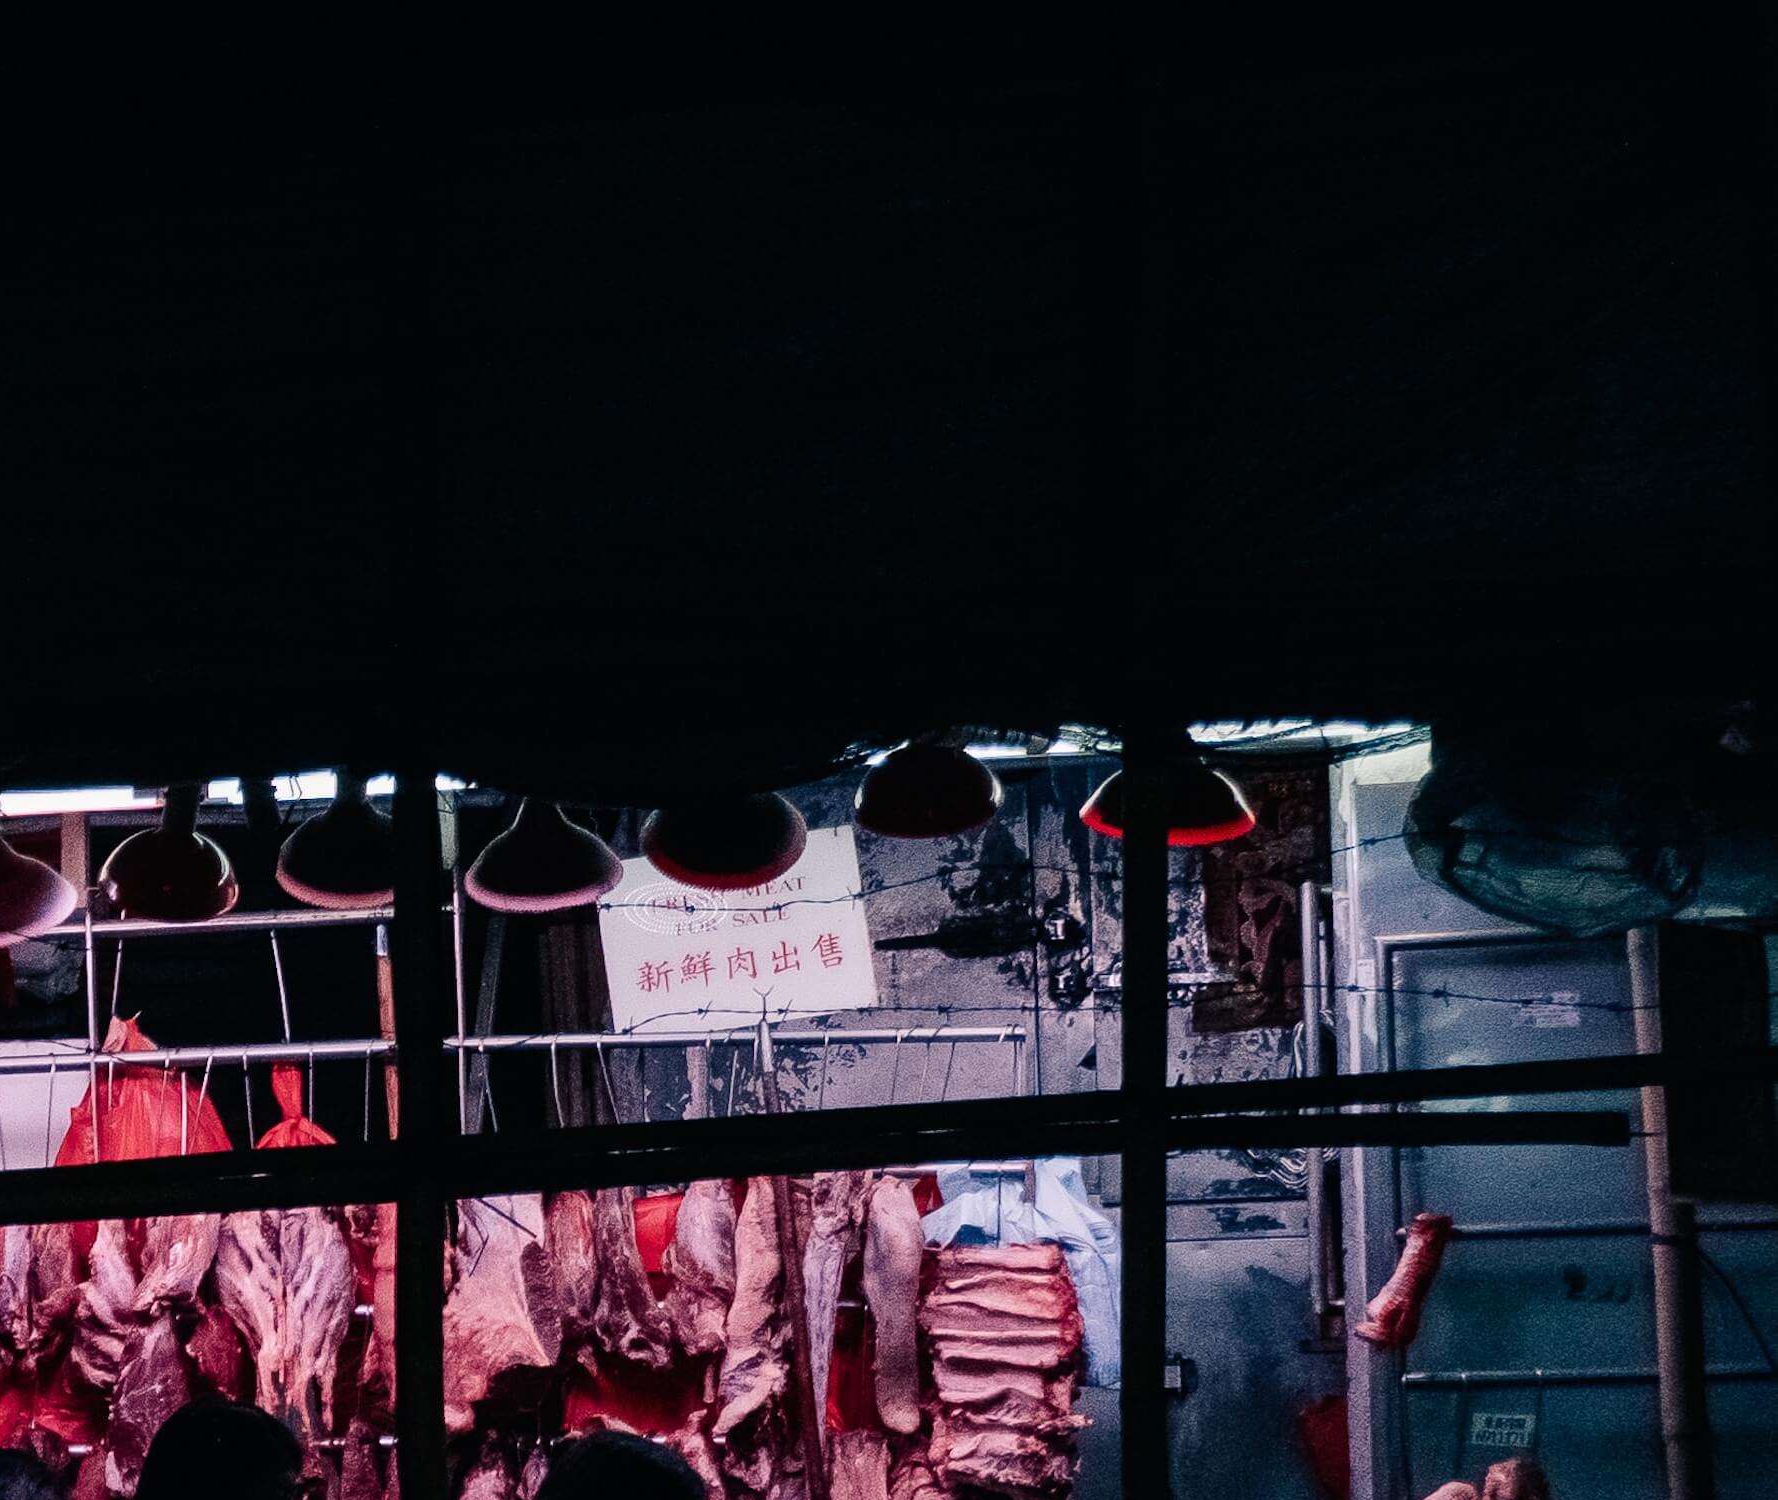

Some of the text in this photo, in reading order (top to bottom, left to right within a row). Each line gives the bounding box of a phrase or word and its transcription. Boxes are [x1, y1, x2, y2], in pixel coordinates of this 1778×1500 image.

[741, 876, 806, 899] MEAT
[732, 907, 791, 928] SALE
[636, 932, 845, 993] 新鮮肉出售
